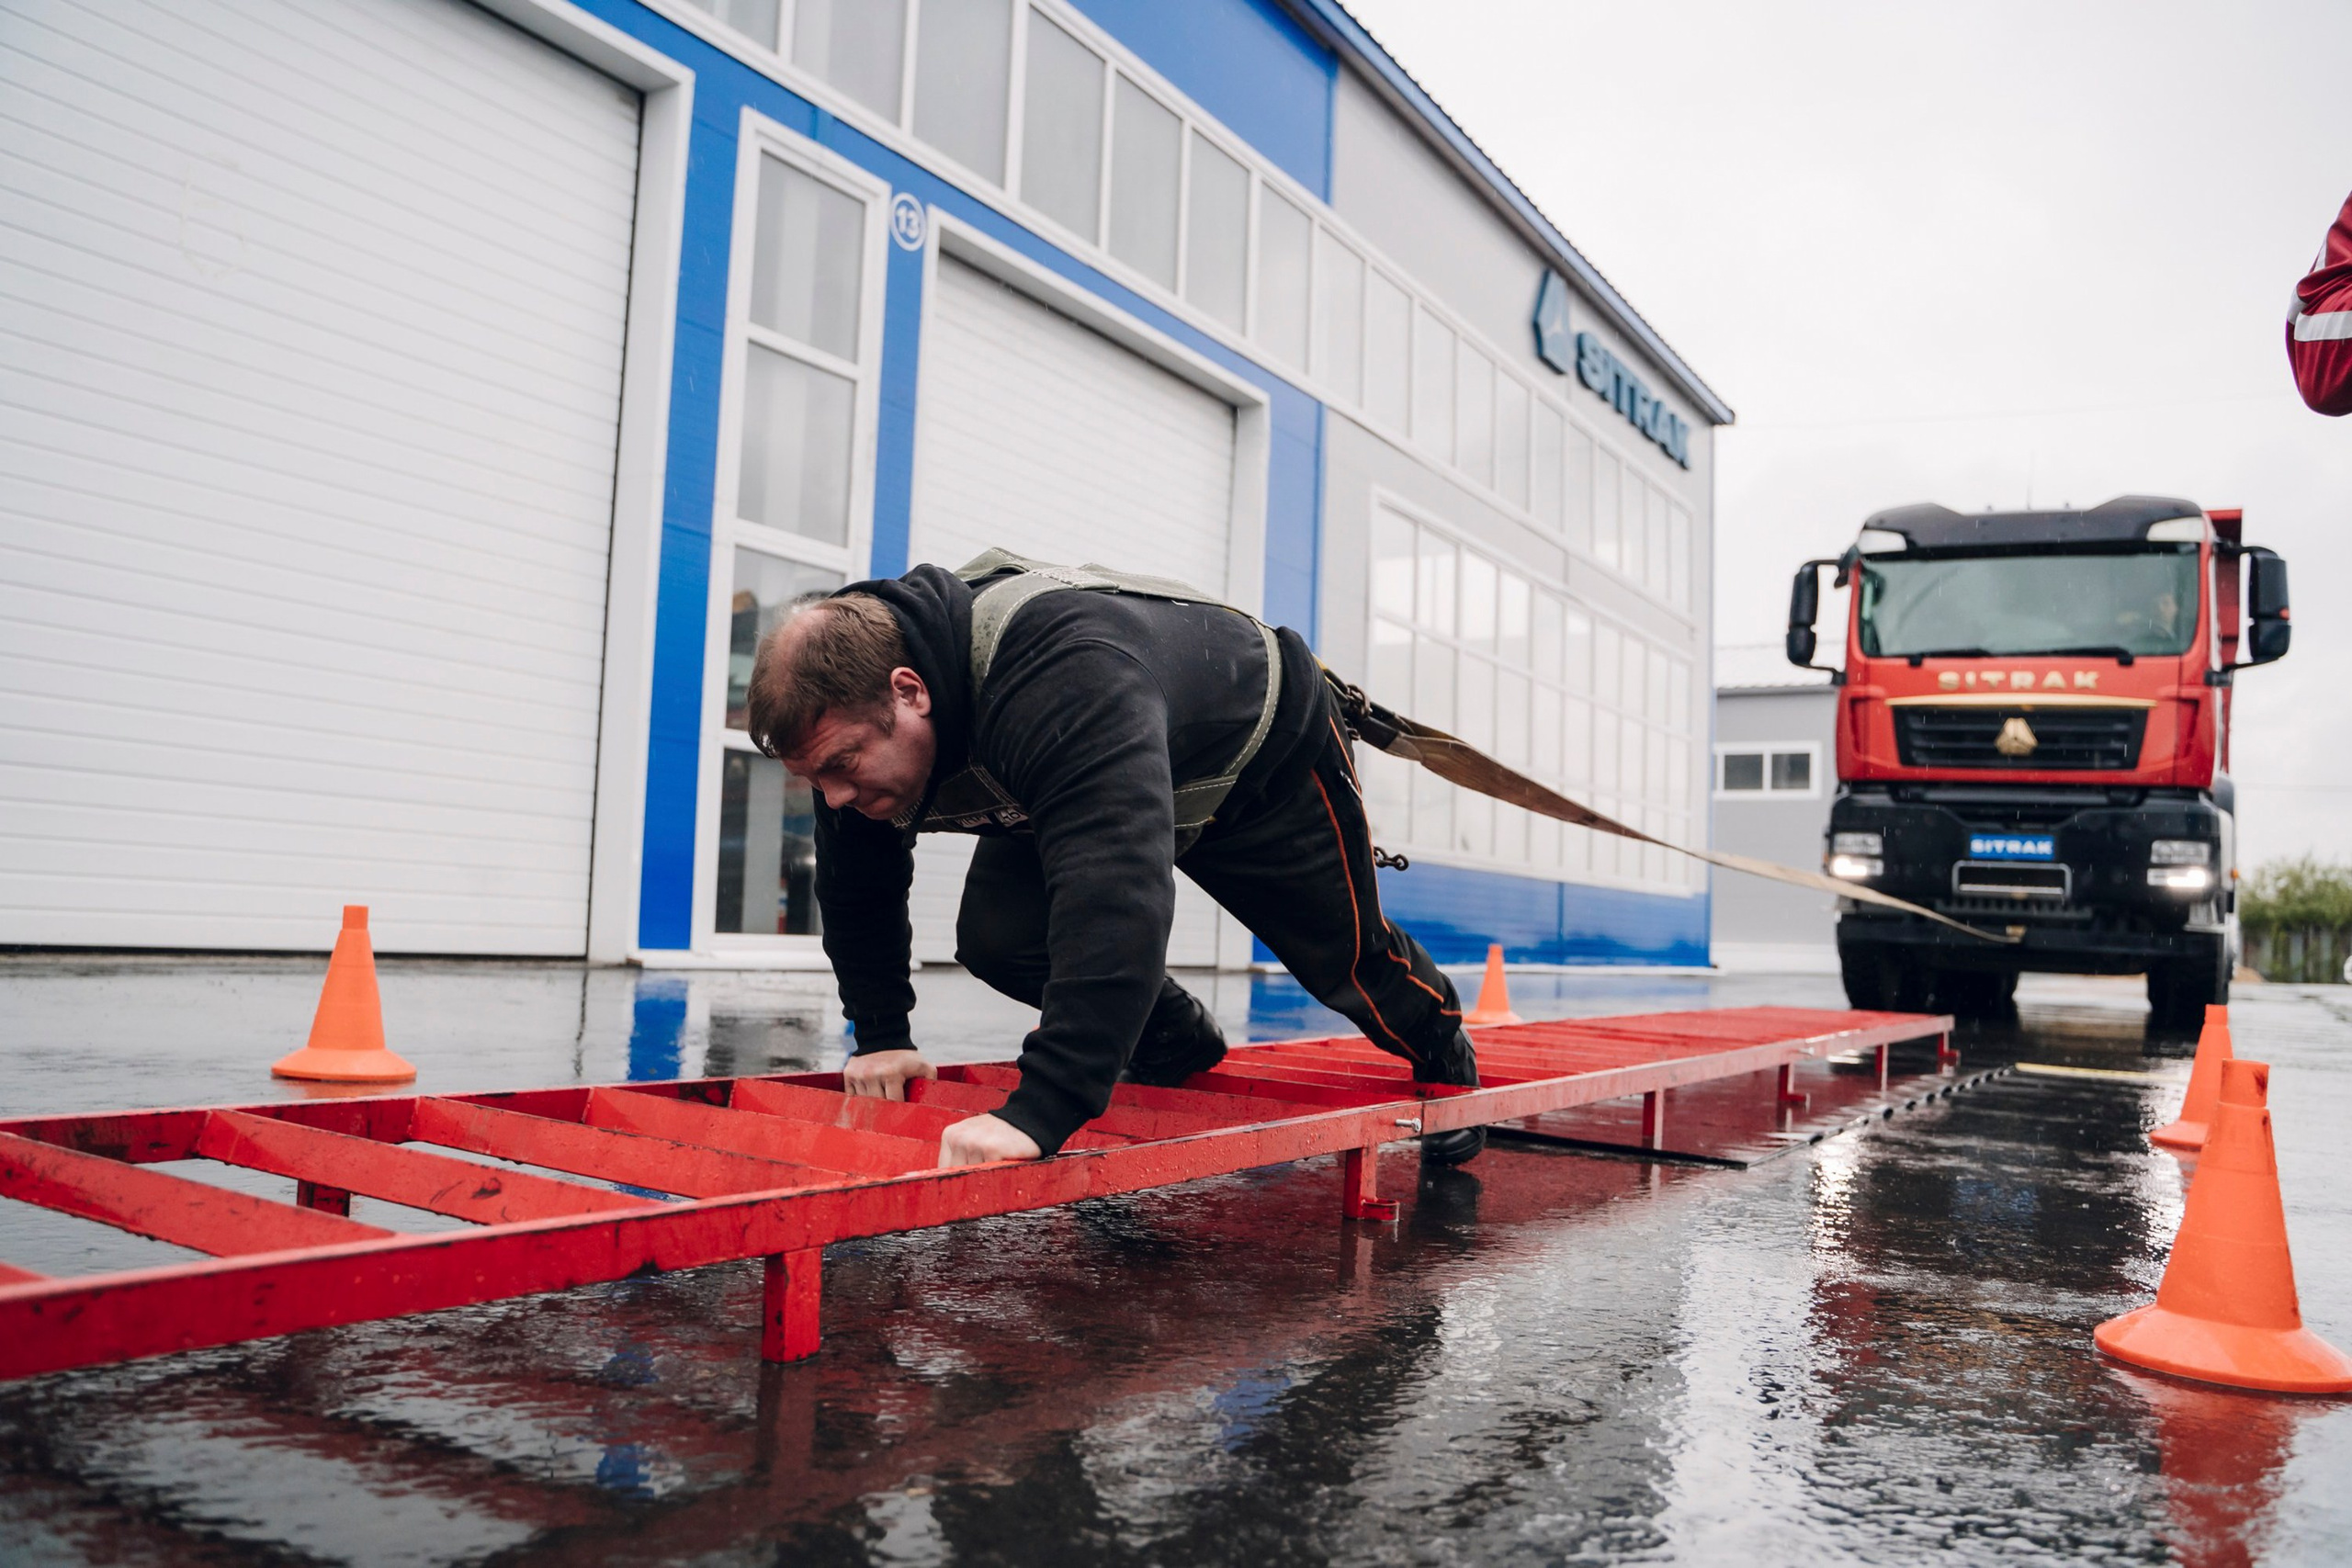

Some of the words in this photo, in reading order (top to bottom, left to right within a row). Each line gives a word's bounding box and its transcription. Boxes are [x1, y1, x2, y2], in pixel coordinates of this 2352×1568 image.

[896, 205, 920, 239] 13
[1938, 670, 2100, 691] SITRAK
[1970, 838, 2053, 855] SITRAK
